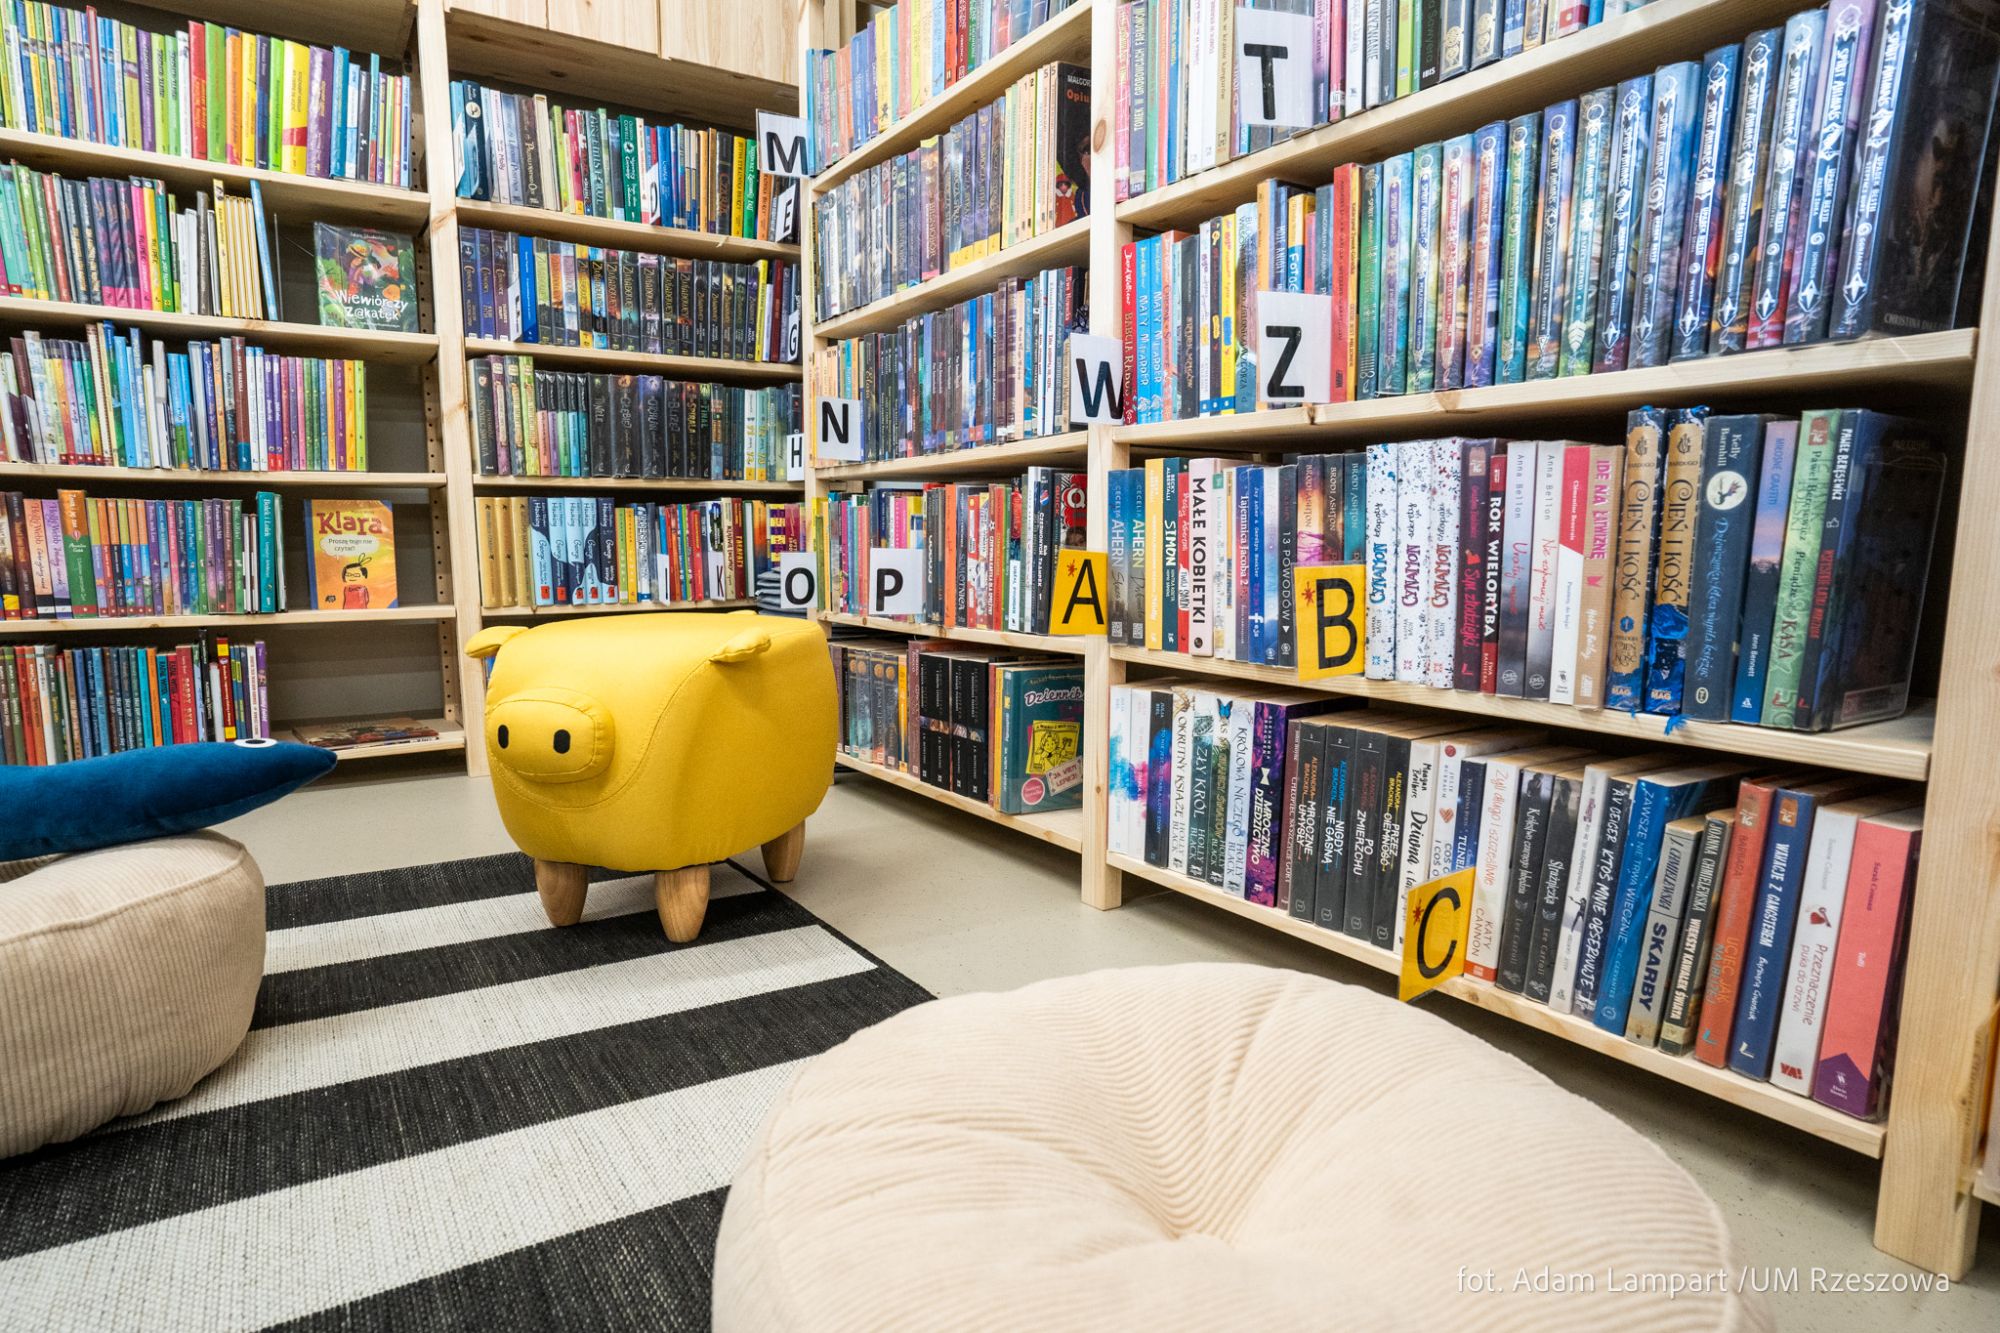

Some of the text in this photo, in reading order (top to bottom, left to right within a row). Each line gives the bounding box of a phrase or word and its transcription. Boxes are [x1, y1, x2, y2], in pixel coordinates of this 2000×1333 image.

[1244, 43, 1288, 120] T
[1827, 48, 1848, 121] SPIRIT ANIMALS
[1877, 31, 1901, 107] SPIRIT ANIMALS
[766, 132, 808, 175] M
[1584, 137, 1596, 196] SPIRIT ANIMALS
[335, 288, 409, 313] Wiewiórczy
[1266, 326, 1304, 397] Z
[1076, 358, 1123, 418] W
[822, 401, 848, 443] N
[1716, 426, 1730, 467] Barnhill
[1728, 434, 1743, 458] Kelly
[790, 437, 803, 468] H
[1807, 450, 1822, 481] Paweł
[1329, 467, 1337, 531] BRODI ASHTON
[1514, 454, 1525, 519] Anna Bellon
[1544, 455, 1555, 520] Anna Bellon
[1626, 480, 1651, 532] CIEŃ
[1669, 480, 1694, 532] CIEŃ
[316, 511, 383, 536] Klara
[1132, 519, 1144, 568] AHERN
[1165, 520, 1176, 566] SIMON
[1240, 495, 1250, 544] Tajemnica
[1193, 478, 1206, 624] MAŁE KOBIETKI
[1283, 532, 1292, 620] 13 POWODÓW
[1370, 542, 1388, 604] CYNAMON
[1402, 545, 1421, 607] CYNAMON
[1432, 544, 1452, 608] CYNAMON
[1484, 497, 1502, 637] ROK WIELORYBA
[1789, 551, 1807, 600] Pieniądze
[716, 565, 725, 593] K
[785, 567, 814, 604] O
[876, 568, 903, 611] P
[1062, 559, 1104, 625] A
[1619, 552, 1641, 602] KOŚĆ
[1660, 552, 1682, 602] KOŚĆ
[1317, 577, 1358, 669] B
[1460, 568, 1480, 647] Syn złodziejki
[1746, 633, 1760, 677] Jenn Bennett
[1778, 619, 1798, 659] KASA
[1024, 686, 1084, 707] Dziennik
[1192, 746, 1209, 819] ZŁY KRÓL
[1231, 727, 1249, 838] KRÓLOWA NICZEGO
[1310, 757, 1318, 796] ALEXANDRA
[1331, 767, 1340, 800] BRACKEN
[1339, 760, 1347, 801] ALEXANDRA
[1251, 787, 1264, 865] DZIEDZICTWO
[1261, 799, 1273, 858] MROCZNE
[1296, 804, 1307, 846] UMYSŁY
[1305, 800, 1317, 855] MROCZNE
[1322, 805, 1337, 863] NIE GASNĄ
[1335, 820, 1347, 855] NIGDY
[1408, 811, 1429, 865] Dziwna
[1635, 790, 1655, 838] ZAWSZE
[1189, 826, 1198, 860] BLACK
[1194, 828, 1206, 863] HOLLY
[1227, 841, 1236, 875] BLACK
[1235, 843, 1246, 879] HOLLY
[1353, 810, 1367, 876] ZMIERZCHU
[1365, 838, 1375, 855] PO
[1380, 813, 1393, 866] CIEMNOŚĆ
[1390, 824, 1401, 857] PRZEZ
[1443, 843, 1453, 863] COŚ
[1767, 842, 1790, 880] WAKACJE
[1600, 849, 1615, 881] KTOŚ
[1659, 848, 1681, 910] CHMIELEWSKA
[1870, 861, 1883, 884] Sarah
[1592, 882, 1610, 914] MNIE
[1617, 888, 1638, 943] WIECZNIE
[1669, 823, 1723, 1020] JOANNA CHMIELEWSKA WIĘKSZY KAWAŁEK ŚWIATA
[1758, 893, 1780, 948] GANGSTEREM
[1417, 887, 1461, 979] C
[1472, 907, 1486, 957] CANNON
[1483, 920, 1494, 949] KATY
[1536, 927, 1551, 976] Lee Carroll
[1579, 917, 1604, 989] OBSERWUJE
[1639, 922, 1669, 1010] SKARBY
[1791, 945, 1809, 1013] puka do drzwi
[1802, 943, 1829, 1026] Przeznaczenie
